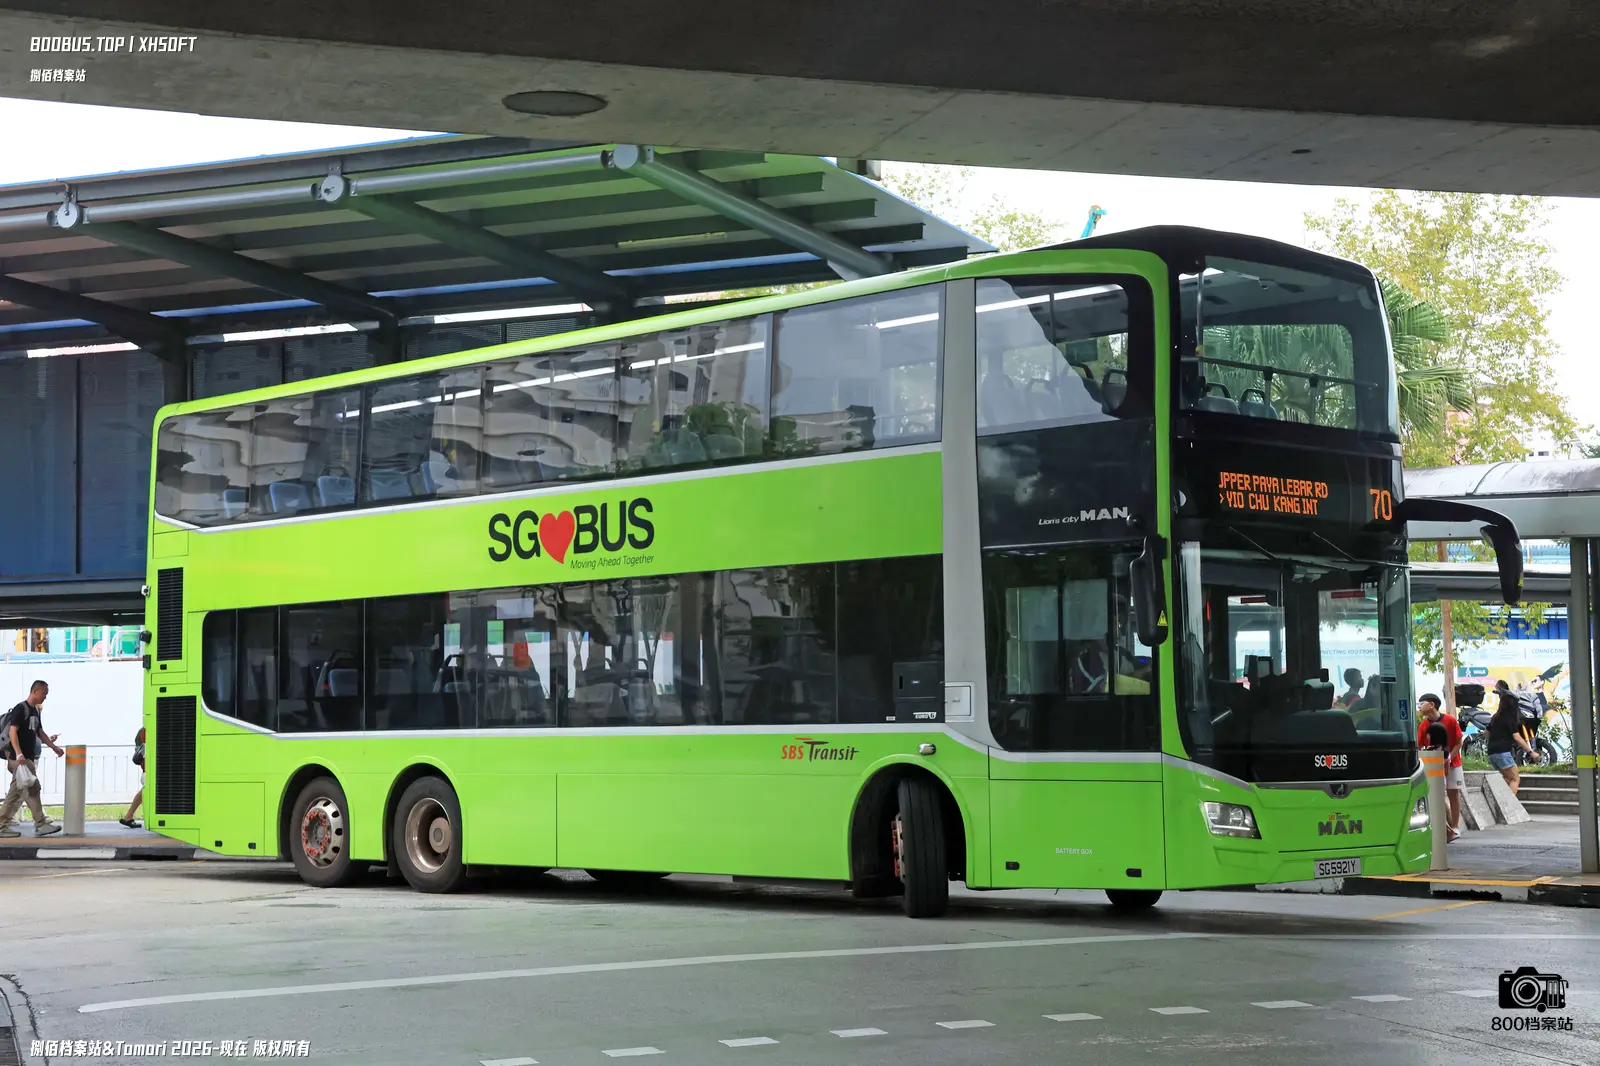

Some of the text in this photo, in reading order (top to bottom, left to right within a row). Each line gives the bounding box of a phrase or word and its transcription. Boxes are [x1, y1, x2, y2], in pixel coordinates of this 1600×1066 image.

[1252, 475, 1279, 494] PAYA
[1281, 478, 1313, 497] LEBAR
[1314, 482, 1329, 499] RD
[1226, 491, 1318, 516] YIO CHU KANG INT
[1369, 489, 1393, 521] 70
[1038, 506, 1128, 526] Lion's City MAN
[570, 555, 655, 570] Moving Ahead Together
[781, 740, 859, 763] SBS Transit
[1318, 819, 1363, 836] MAN
[1318, 860, 1356, 876] SG5921Y
